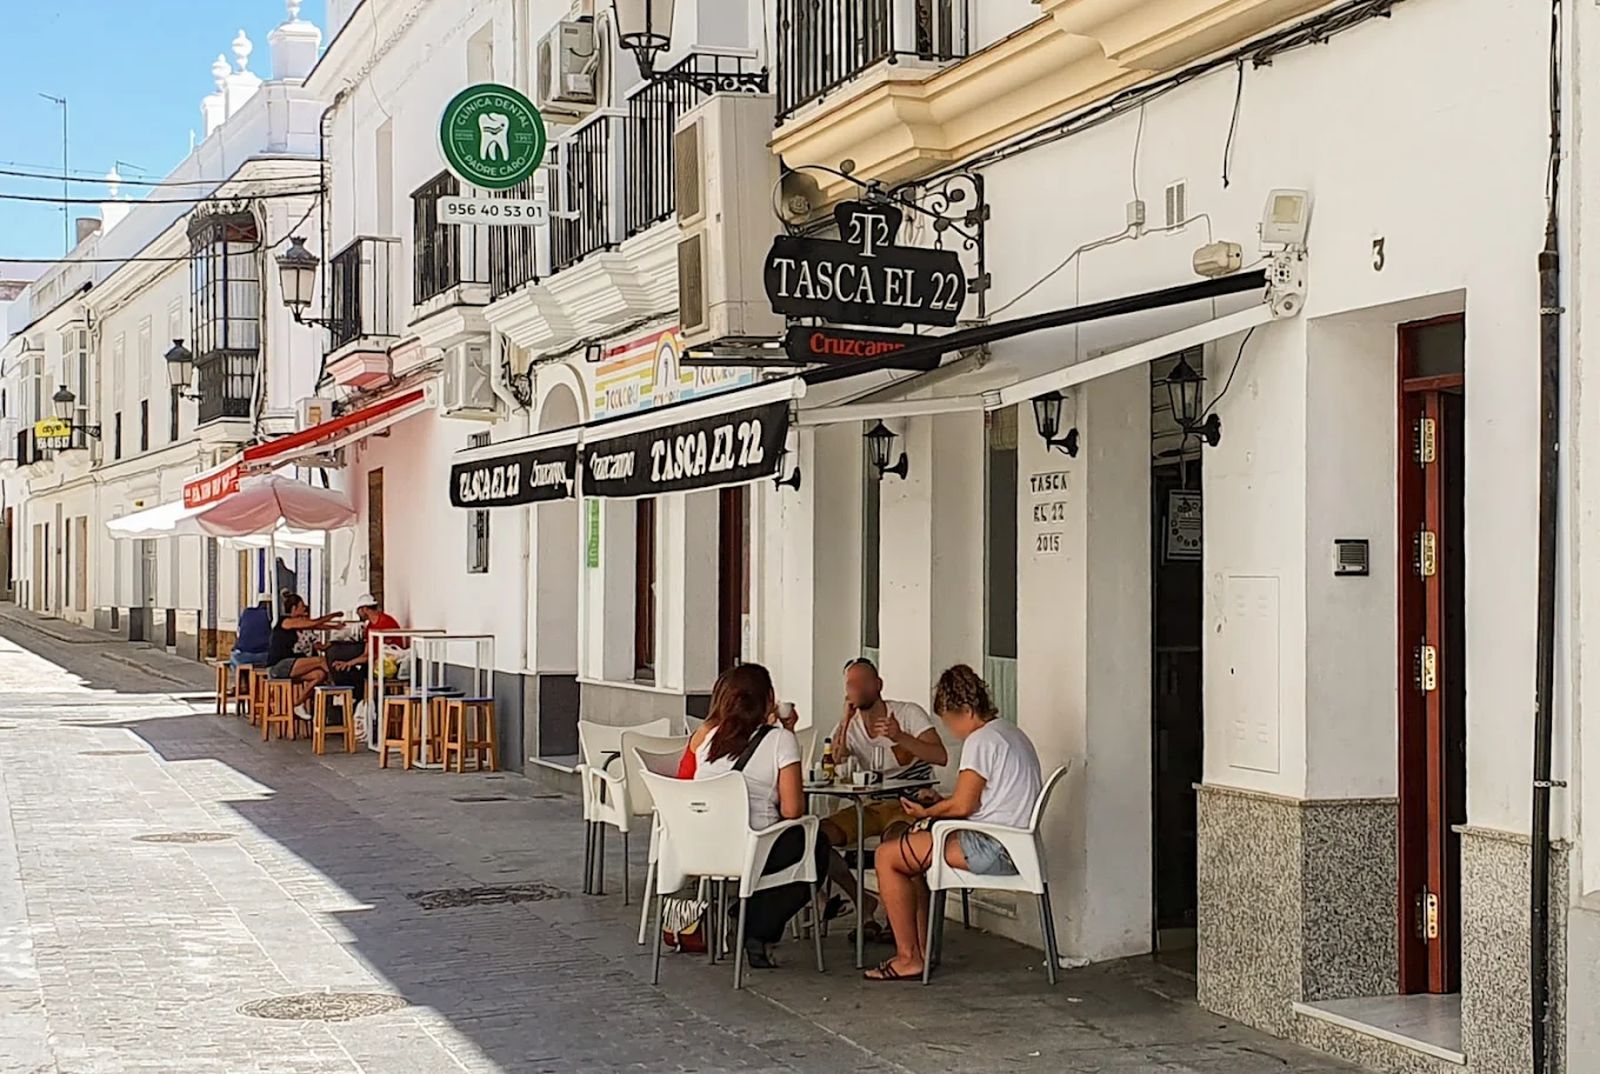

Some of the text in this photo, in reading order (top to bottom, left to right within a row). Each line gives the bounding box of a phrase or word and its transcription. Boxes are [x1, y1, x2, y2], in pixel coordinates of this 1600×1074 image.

[495, 98, 529, 128] DENTAL
[465, 155, 526, 176] PADRE CARO
[448, 203, 542, 218] 956 40 53 01
[1372, 236, 1385, 272] 3
[773, 258, 960, 311] TASCA EL 22
[809, 332, 906, 357] Cruzcam
[650, 430, 707, 482] TASCA
[708, 424, 735, 472] EL
[737, 419, 764, 467] 22
[1030, 474, 1067, 493] TASCA
[1033, 503, 1064, 522] EL 22
[1036, 535, 1060, 552] 2015
